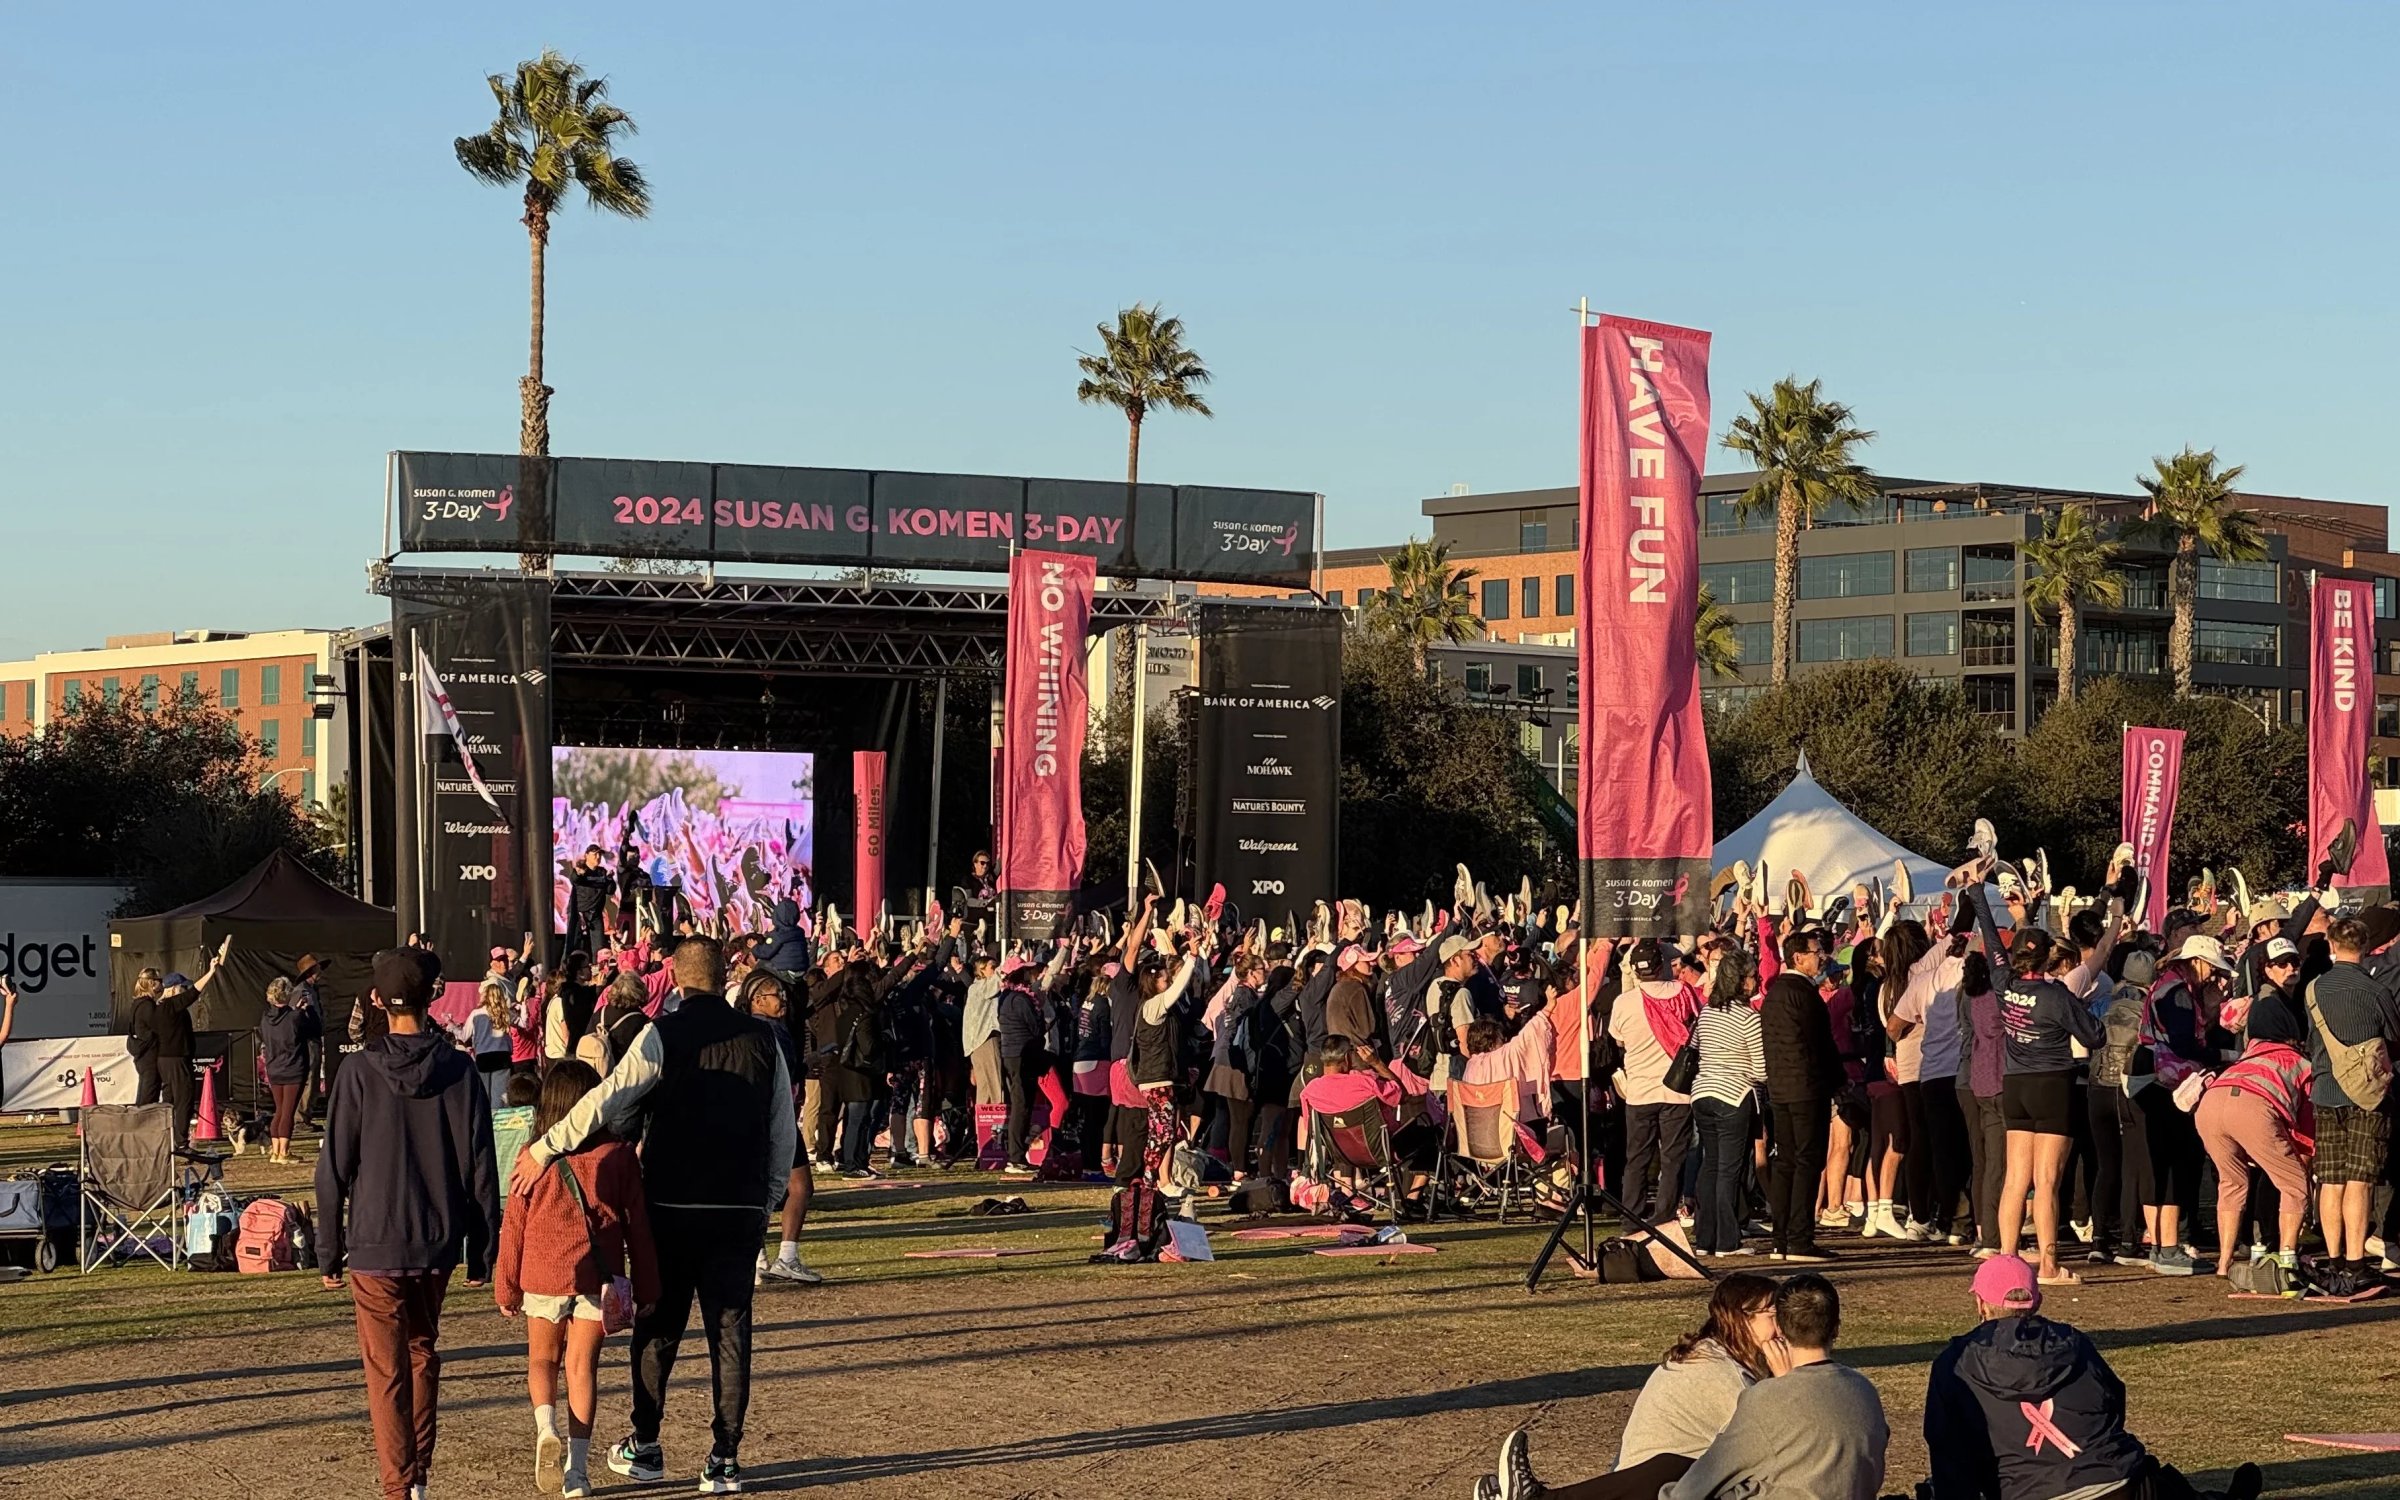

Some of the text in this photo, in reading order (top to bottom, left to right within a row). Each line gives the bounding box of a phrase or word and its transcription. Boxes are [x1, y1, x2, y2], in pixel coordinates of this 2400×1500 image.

[1629, 336, 1666, 603] HAVE FUN
[613, 496, 1124, 545] 2024 SUSAN G. KOMEN 3-DAY
[2334, 589, 2356, 712] BE KIND
[1034, 561, 1065, 777] NO WHINING
[439, 673, 456, 683] OF
[459, 673, 519, 685] AMERICA
[1203, 697, 1310, 710] BANK OF AMERICA
[1246, 765, 1293, 776] MOHAWK
[2140, 739, 2165, 847] COMMAND
[1233, 801, 1270, 811] NATURE'S
[444, 821, 511, 838] Walgreens
[868, 784, 881, 857] 60 Miles.
[1238, 839, 1299, 855] Walgreens
[459, 865, 497, 880] XPO
[1252, 880, 1285, 895] XPO
[2003, 989, 2037, 1008] 2024
[65, 1069, 78, 1088] 8
